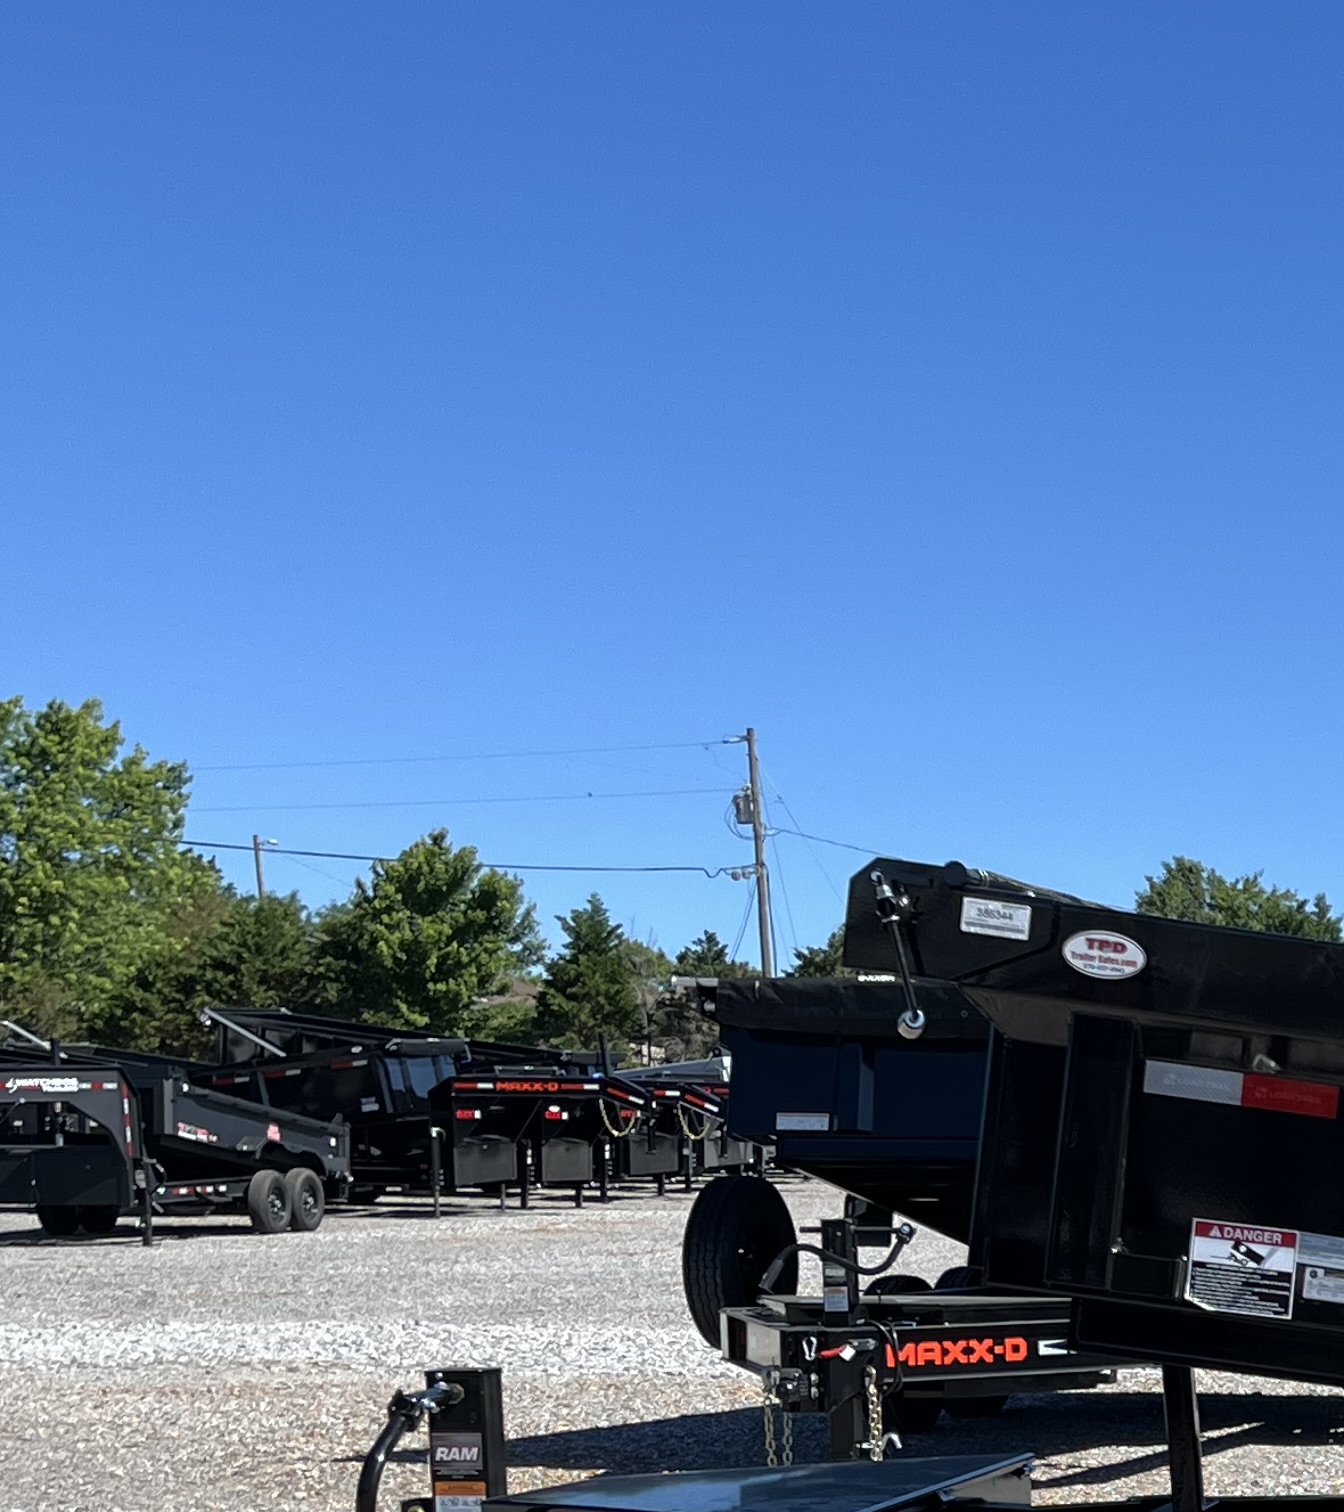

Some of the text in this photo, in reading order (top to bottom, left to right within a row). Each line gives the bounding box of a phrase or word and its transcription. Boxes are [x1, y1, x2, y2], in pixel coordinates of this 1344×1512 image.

[1086, 937, 1129, 954] TPD
[1223, 1226, 1282, 1245] DANGER
[885, 1336, 1028, 1368] MAXX-D
[435, 1446, 479, 1461] RAM
